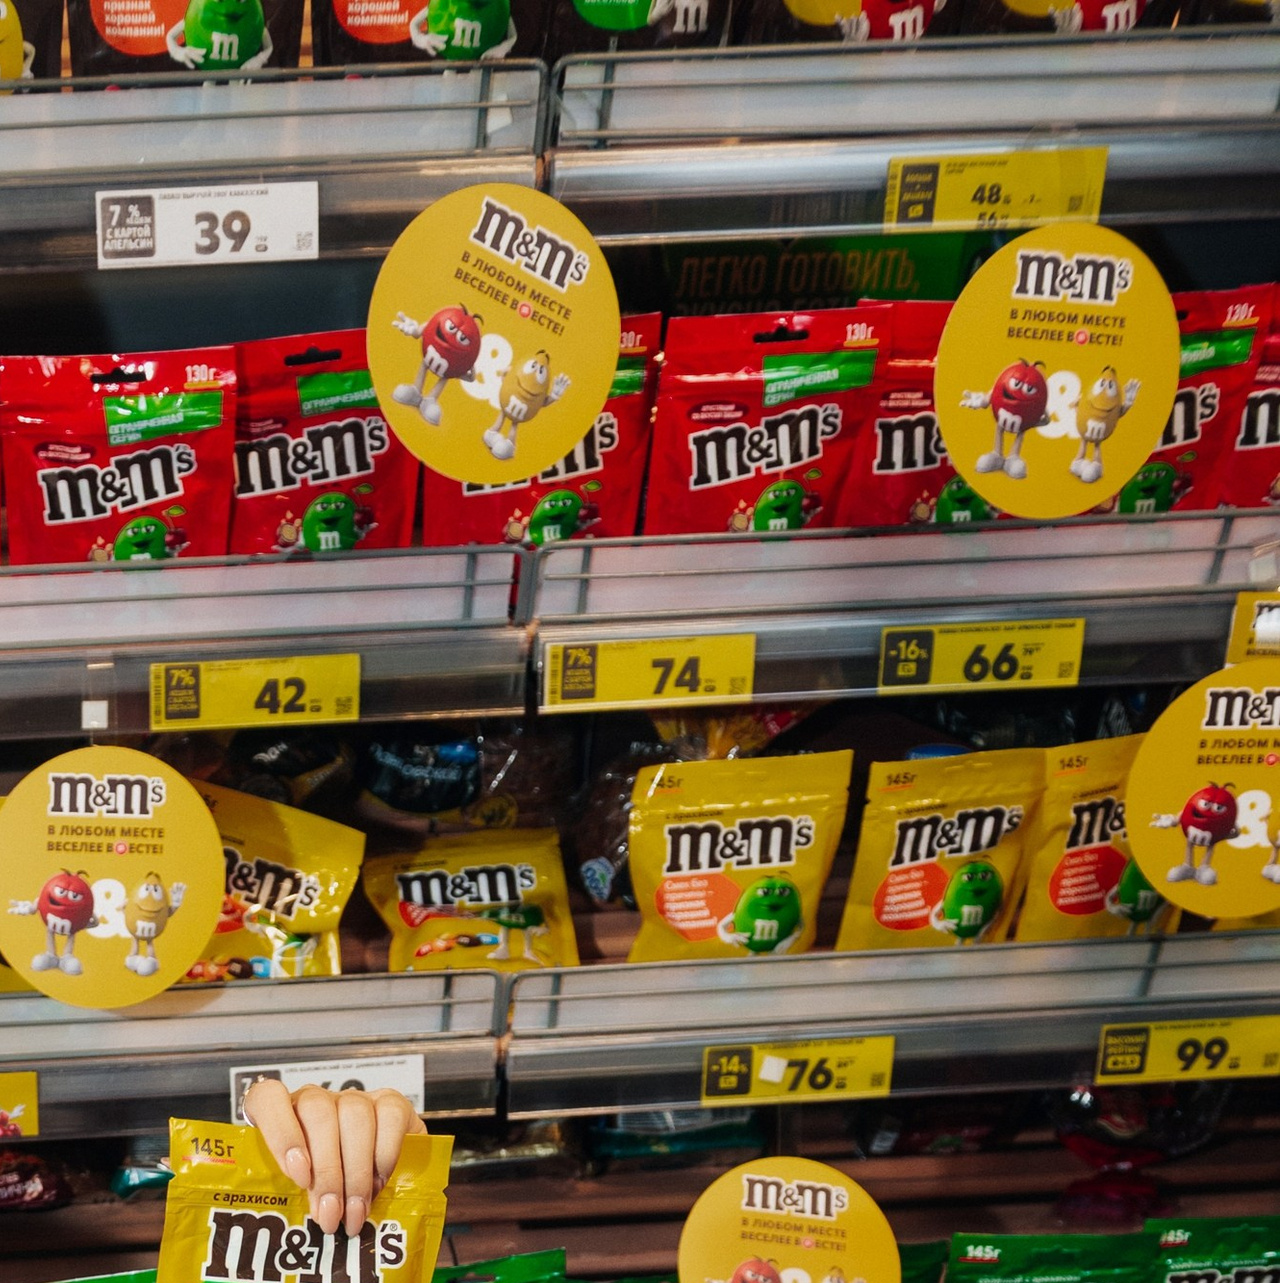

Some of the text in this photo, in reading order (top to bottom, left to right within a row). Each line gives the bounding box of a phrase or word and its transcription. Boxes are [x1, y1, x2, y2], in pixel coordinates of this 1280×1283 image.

[105, 12, 156, 24] хорошей
[347, 11, 410, 27] компании!
[105, 24, 165, 37] компании!
[971, 184, 1001, 206] 48
[109, 205, 121, 226] 7
[105, 226, 151, 240] С КАРТОЙ
[194, 210, 251, 256] 39
[103, 238, 154, 252] АПЕЛЬСИН
[472, 200, 588, 289] m&m's
[675, 247, 920, 298] ЛЕГКО ГОТОВИТЬ,
[1014, 254, 1131, 303] m&m's
[454, 267, 509, 305] ВЕСЕЛЕЕ
[461, 250, 573, 320] В ЛЮБОМ МЕСТЕ
[1010, 309, 1126, 329] В ЛЮБОМ МЕСТЕ
[1226, 303, 1256, 323] 130г
[844, 322, 874, 341] 130г
[1007, 326, 1064, 342] ВЕСЕЛЕЕ
[184, 364, 218, 385] 130г
[691, 404, 841, 487] m&m's
[235, 416, 388, 497] m&m's
[39, 444, 197, 523] m&m's
[963, 643, 1019, 683] 66
[169, 669, 195, 687] 7%
[651, 656, 701, 695] 74
[254, 677, 306, 715] 42
[1210, 739, 1273, 750] ЛЮБОМ
[1197, 754, 1255, 766] ВЕСЕЛЕЕ
[886, 772, 917, 788] 145г
[48, 772, 165, 818] m&m's
[48, 825, 165, 838] В ЛЮБОМ МЕСТЕ
[892, 806, 1021, 868] m&m's
[47, 842, 103, 853] ВЕСЕЛЕЕ
[663, 815, 814, 874] m&m's
[397, 864, 536, 905] m&m's
[1177, 1036, 1230, 1072] 99
[787, 1057, 834, 1092] 76
[191, 1137, 235, 1158] 145г
[223, 1191, 288, 1207] арахисом
[744, 1175, 848, 1219] m&m's
[966, 1245, 1002, 1259] 145г
